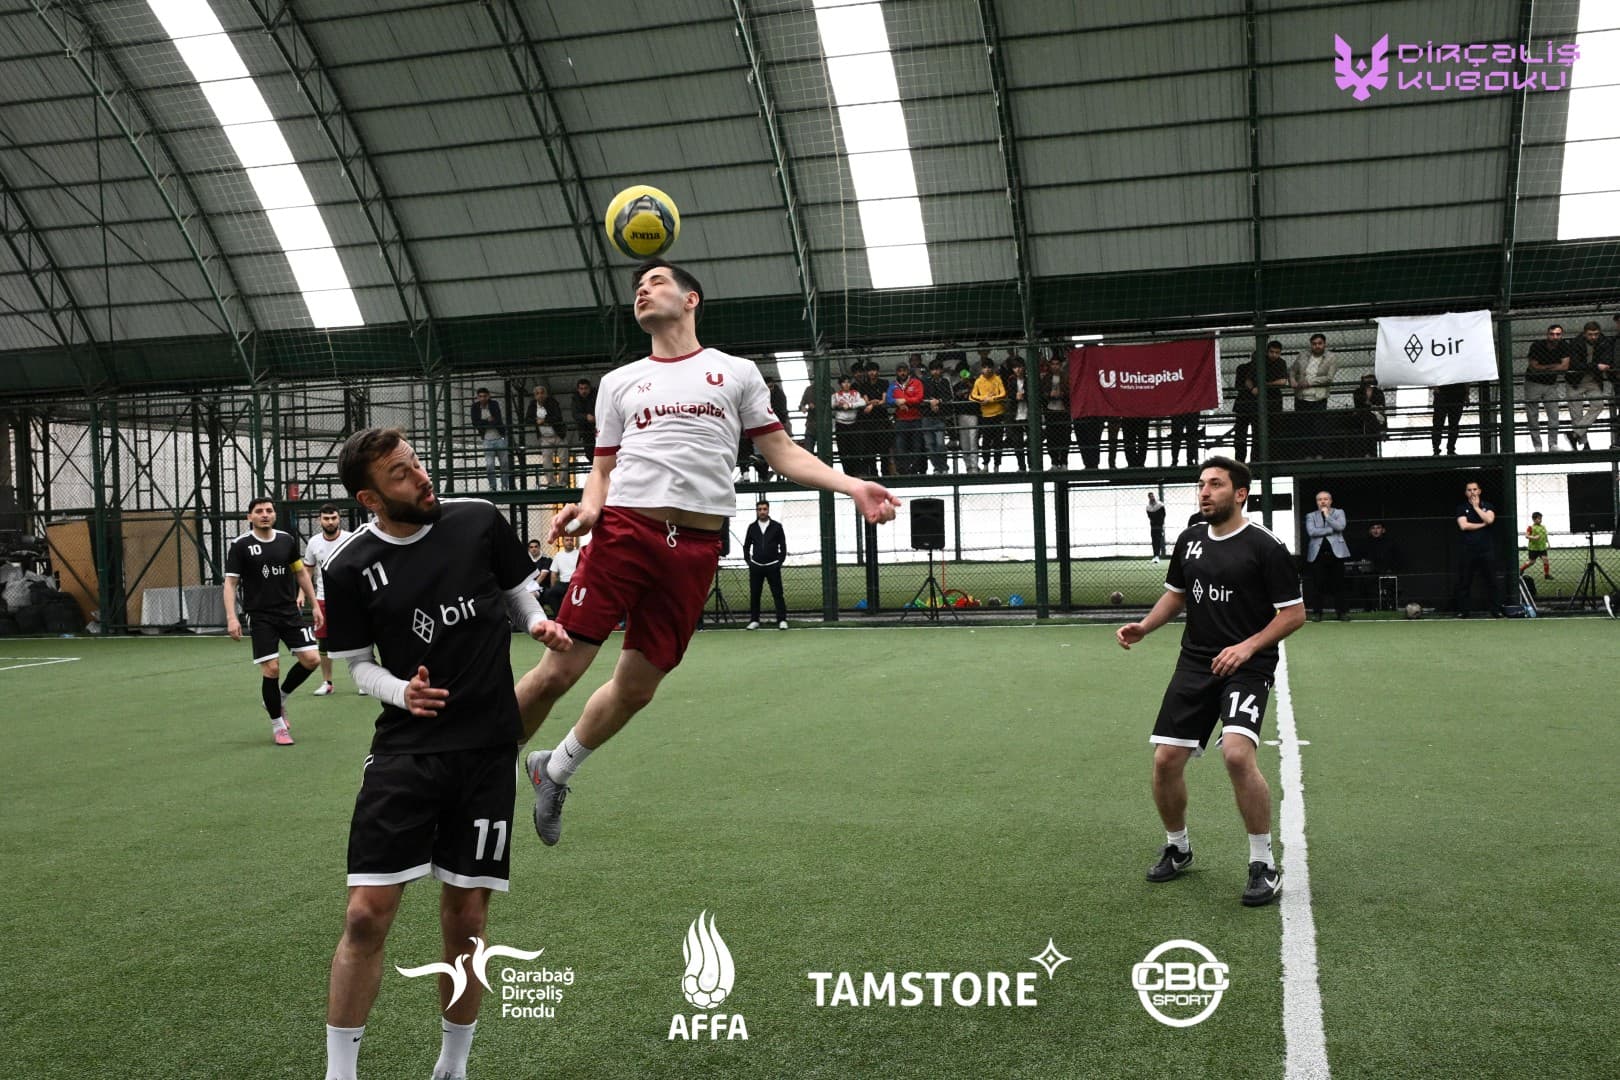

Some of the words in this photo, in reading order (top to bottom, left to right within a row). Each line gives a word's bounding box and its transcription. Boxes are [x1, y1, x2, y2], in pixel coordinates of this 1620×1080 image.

[1431, 337, 1465, 357] bir
[1120, 368, 1184, 386] Unicapital
[247, 544, 263, 556] 10
[1185, 540, 1203, 560] 14
[271, 565, 286, 576] bir
[362, 561, 390, 592] 11
[1208, 583, 1234, 603] bir
[439, 596, 477, 627] bir
[1228, 691, 1260, 725] 14
[473, 818, 507, 862] 11
